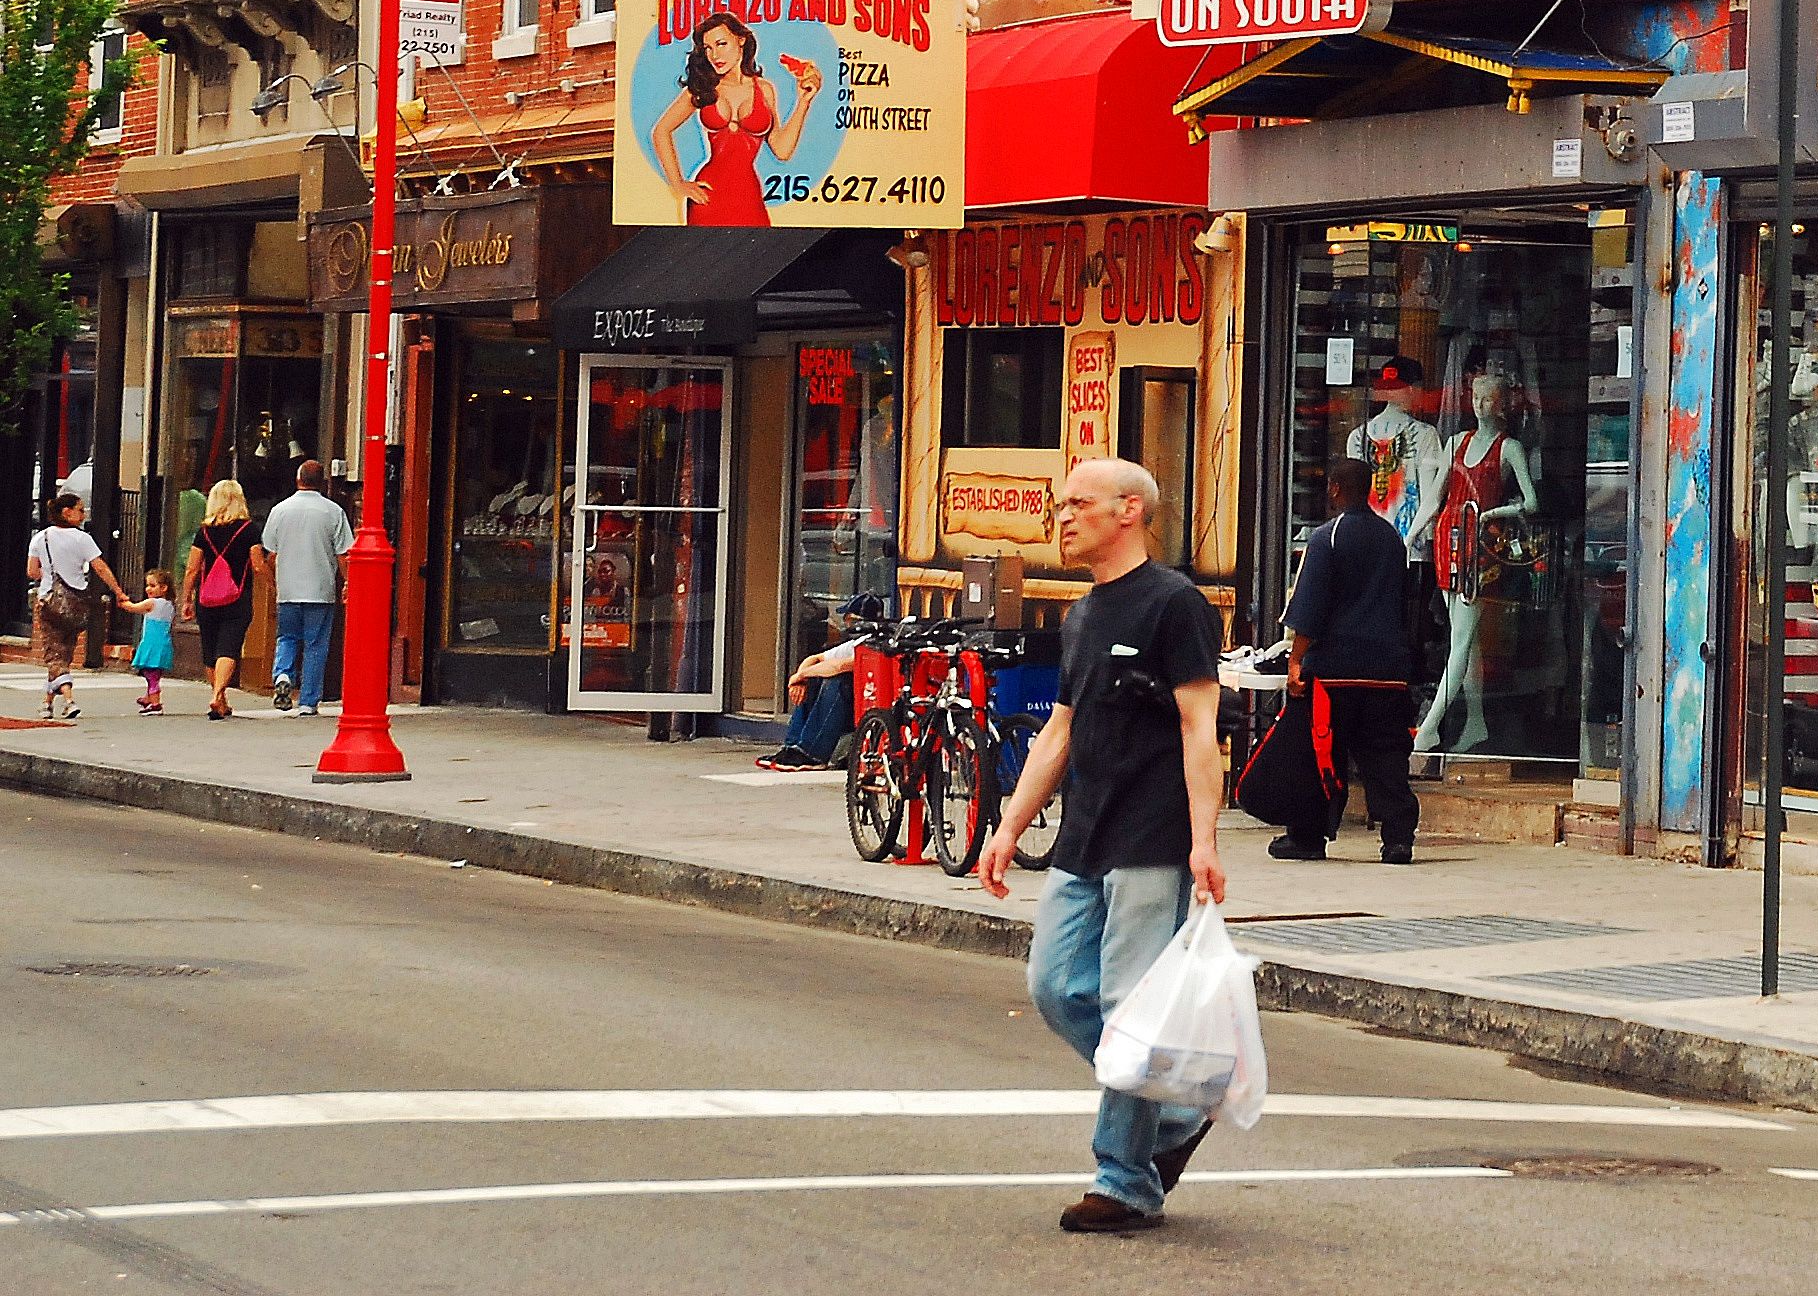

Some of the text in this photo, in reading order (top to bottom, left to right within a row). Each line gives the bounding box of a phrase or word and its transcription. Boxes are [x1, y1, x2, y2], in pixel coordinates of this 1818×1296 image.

[400, 10, 456, 24] riad Realty
[412, 27, 438, 38] (215)
[838, 62, 890, 88] PIZZA
[837, 88, 856, 102] on
[835, 106, 932, 131] SOUTH STREET
[764, 175, 946, 204] 215.627.4110
[936, 220, 1087, 326] LORENZO
[1101, 211, 1206, 326] SONS
[593, 309, 657, 346] EXPOZE
[800, 348, 856, 377] SPECIAL
[1076, 347, 1105, 374] BEST
[809, 376, 845, 404] SALE
[1072, 380, 1106, 414] SLICES
[1079, 420, 1094, 446] ON
[952, 486, 1043, 515] ESTABLISHED 1988
[1027, 701, 1056, 711] DASA
